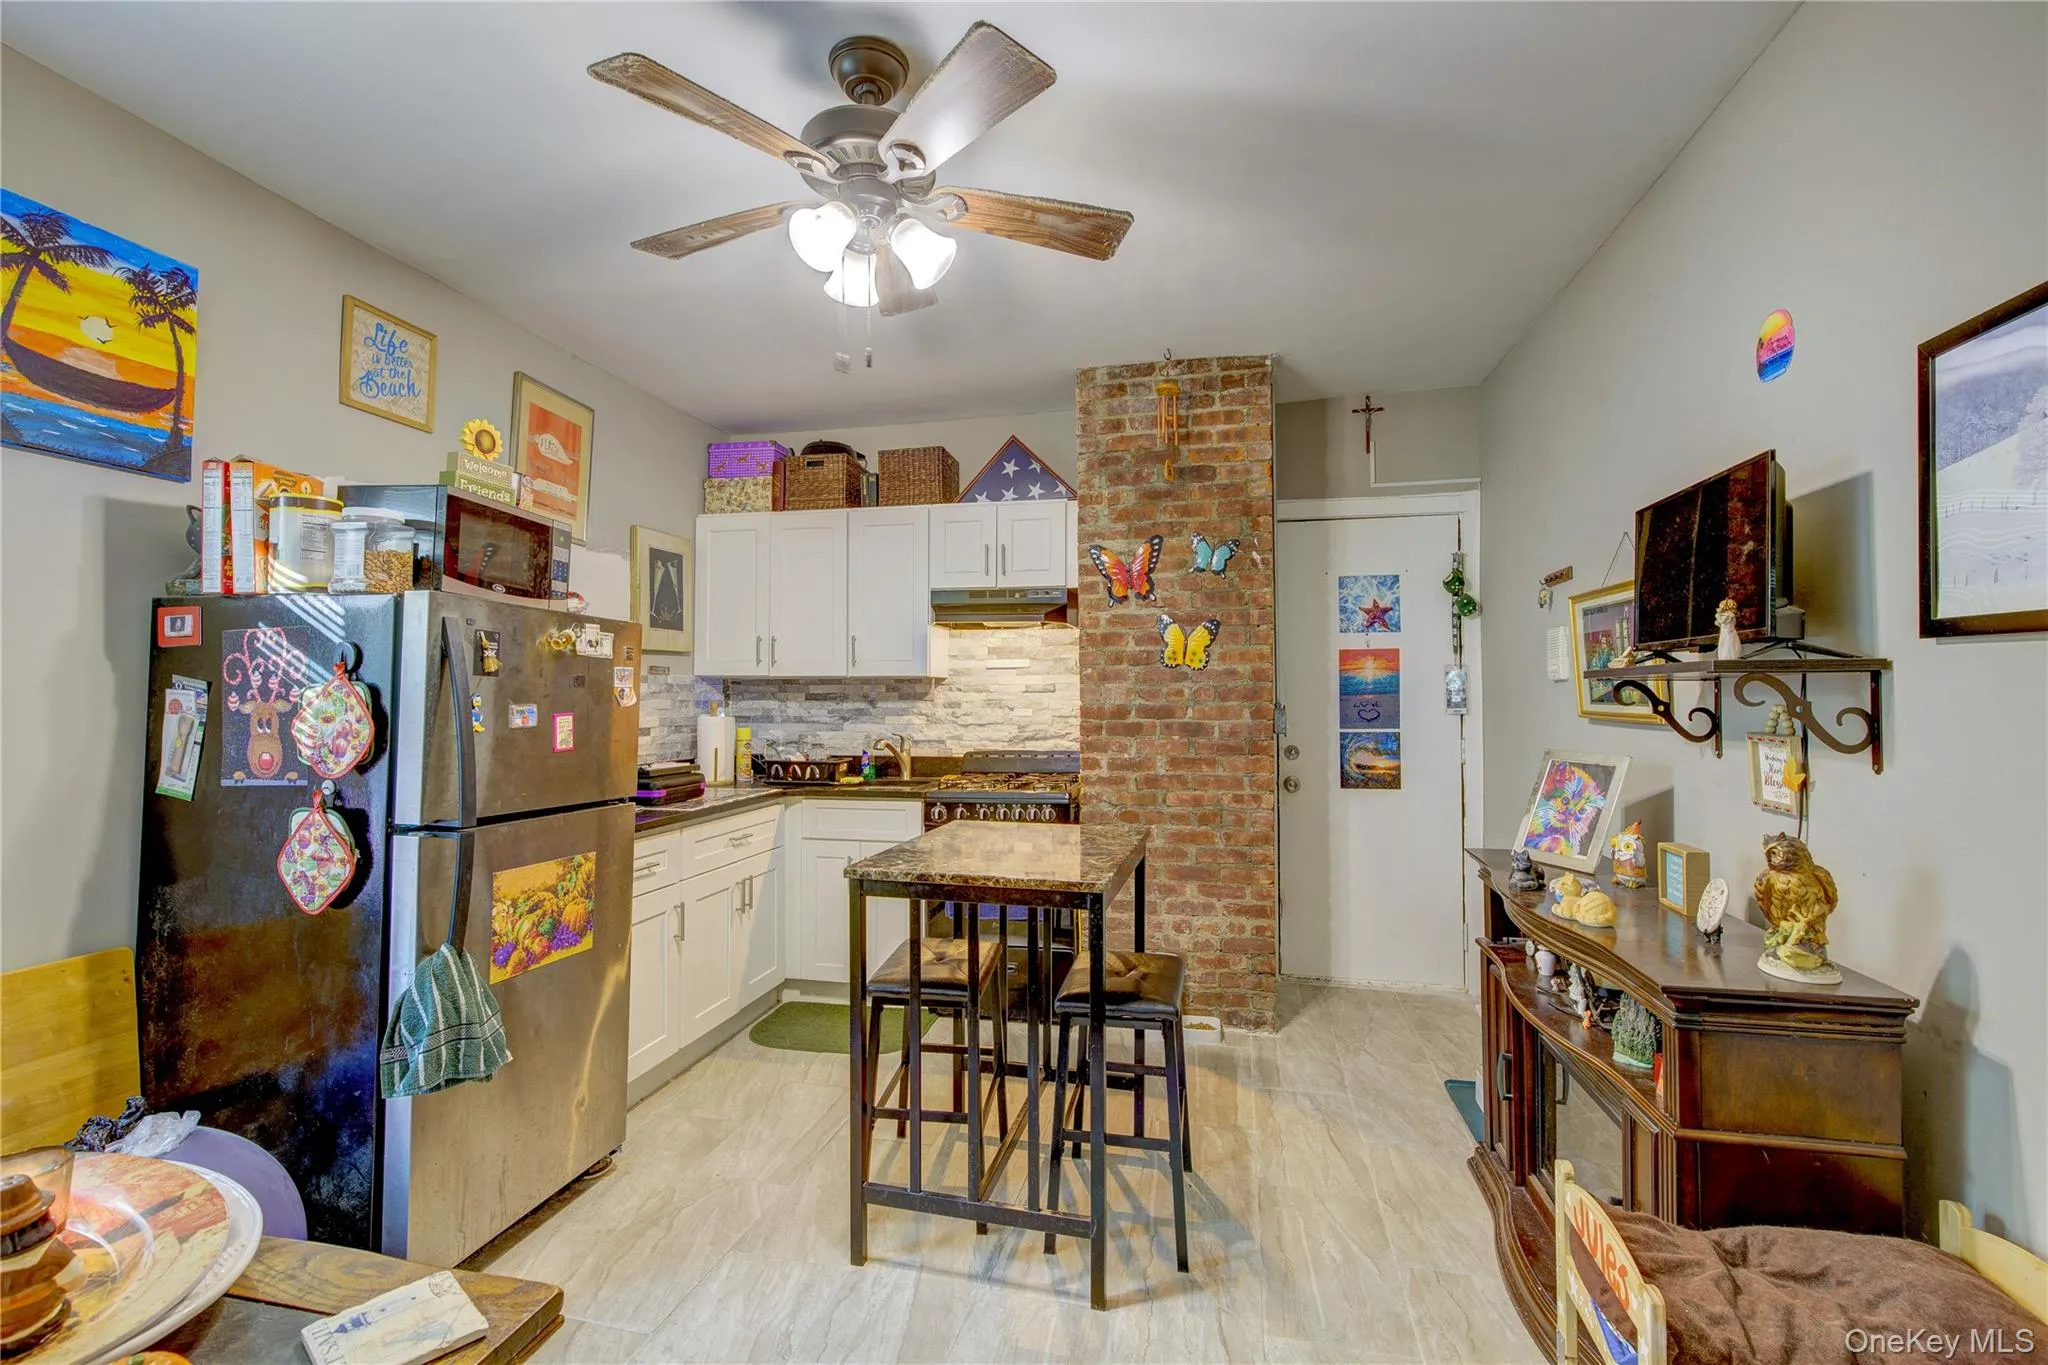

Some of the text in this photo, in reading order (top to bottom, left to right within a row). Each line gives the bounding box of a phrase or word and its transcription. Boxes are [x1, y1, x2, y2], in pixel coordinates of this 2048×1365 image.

[364, 322, 408, 356] Life
[359, 369, 421, 399] Beach
[373, 367, 407, 379] at the
[463, 458, 508, 478] Welcome
[460, 478, 511, 503] Friends
